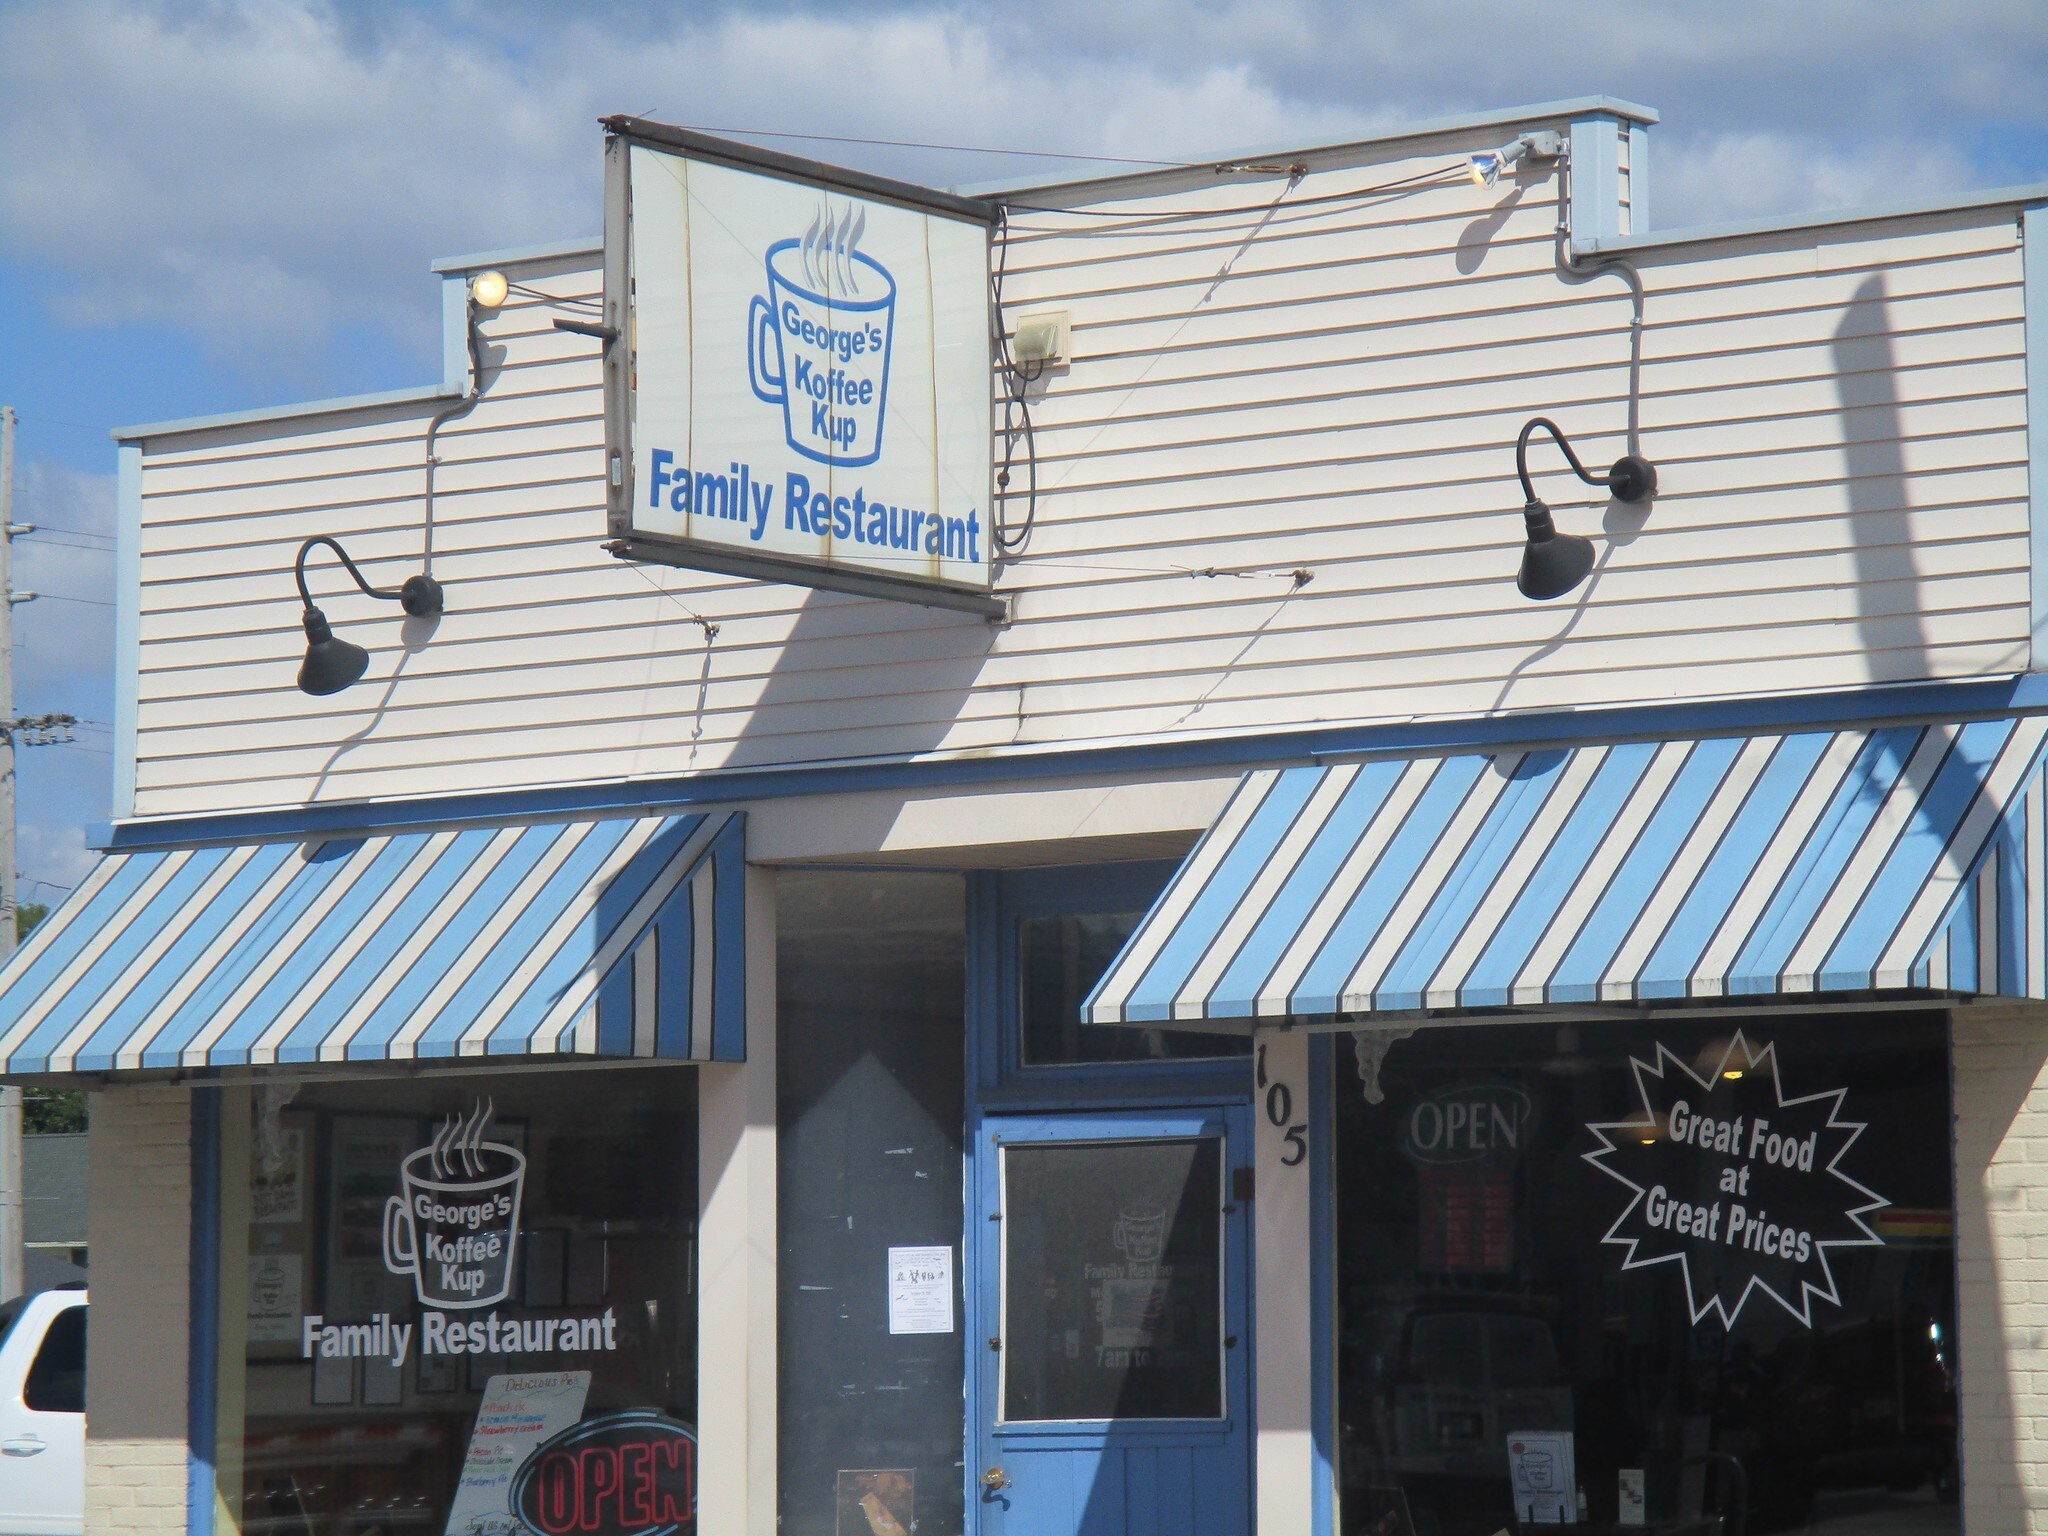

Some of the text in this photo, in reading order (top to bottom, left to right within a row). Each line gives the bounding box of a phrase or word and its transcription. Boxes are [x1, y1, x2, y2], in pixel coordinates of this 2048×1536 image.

[782, 300, 883, 362] George's
[795, 353, 873, 406] Koffee
[812, 400, 857, 452] Kup
[650, 448, 980, 563] Family Restaurant
[1410, 1101, 1518, 1150] OPEN
[1668, 1100, 1818, 1173] Great Food
[1719, 1164, 1750, 1196] at
[414, 1193, 512, 1230] George's
[1646, 1185, 1811, 1264] Great Prices
[425, 1233, 501, 1263] Koffee
[1084, 1263, 1126, 1280] Family
[441, 1262, 485, 1296] Kup
[303, 1307, 617, 1367] Family Restaurant
[538, 1438, 692, 1534] OPEN
